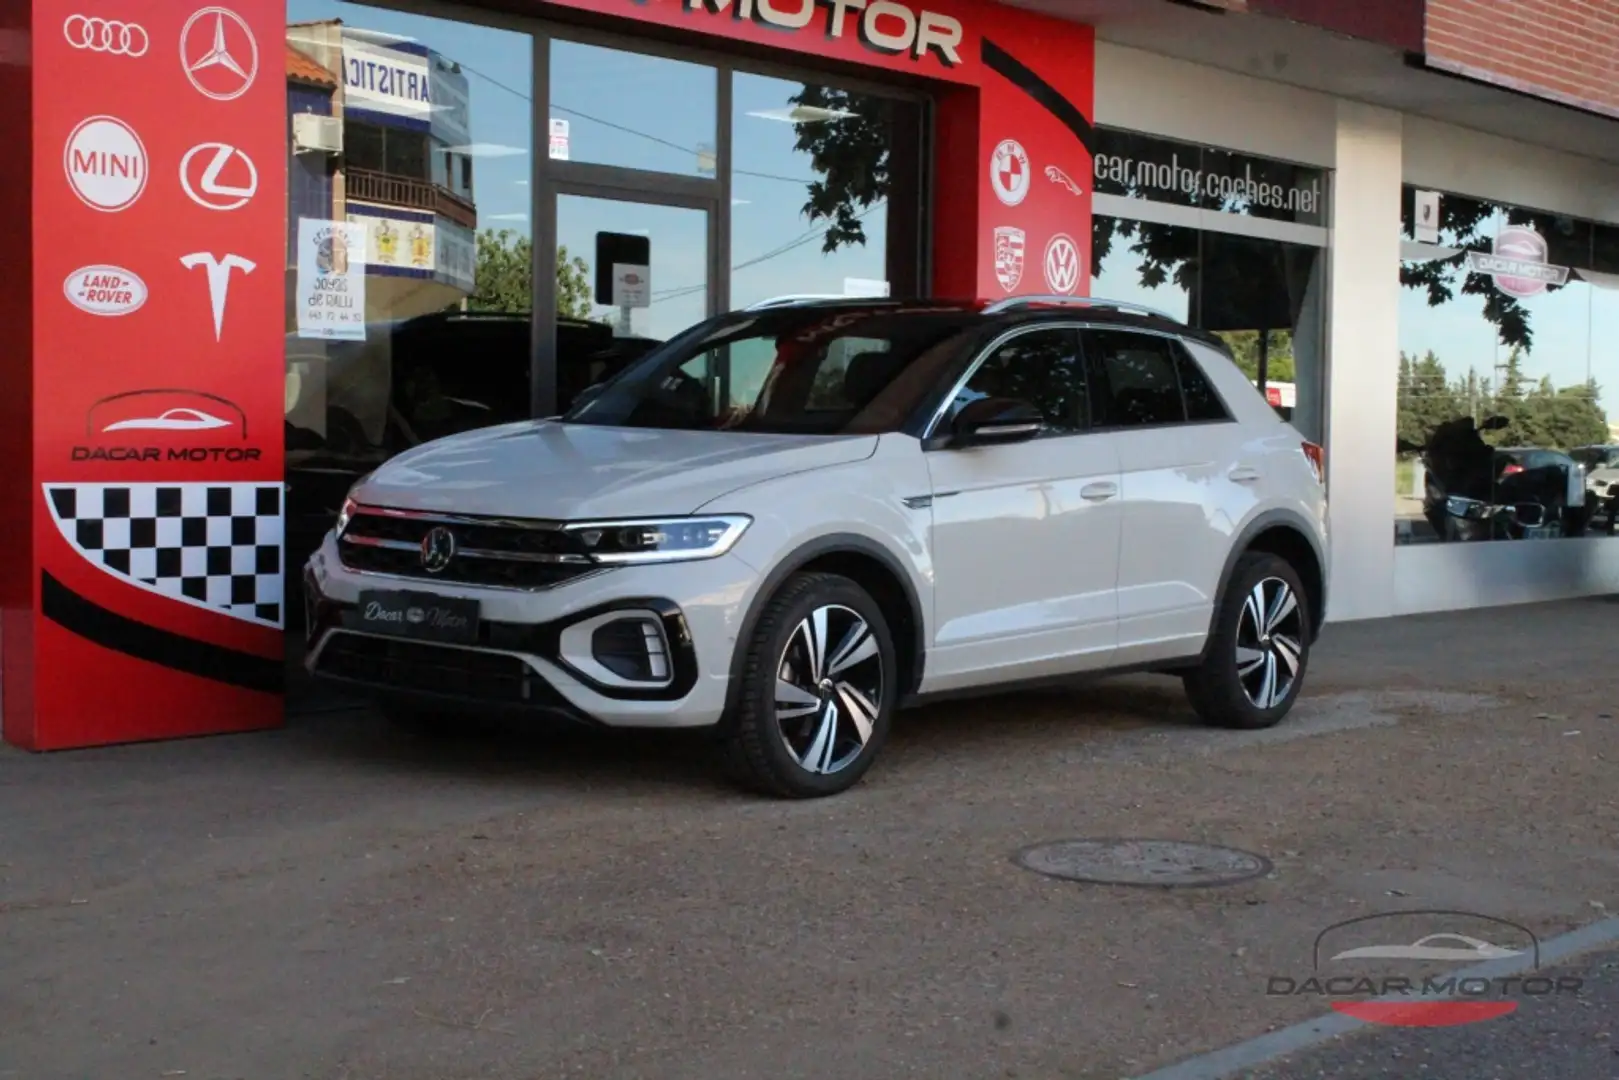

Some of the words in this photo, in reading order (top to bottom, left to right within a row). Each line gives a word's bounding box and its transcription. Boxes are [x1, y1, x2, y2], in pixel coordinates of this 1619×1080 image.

[690, 0, 963, 64] OTOR
[74, 149, 138, 179] MINI
[71, 447, 161, 462] DACAR
[167, 447, 262, 462] MOTOR
